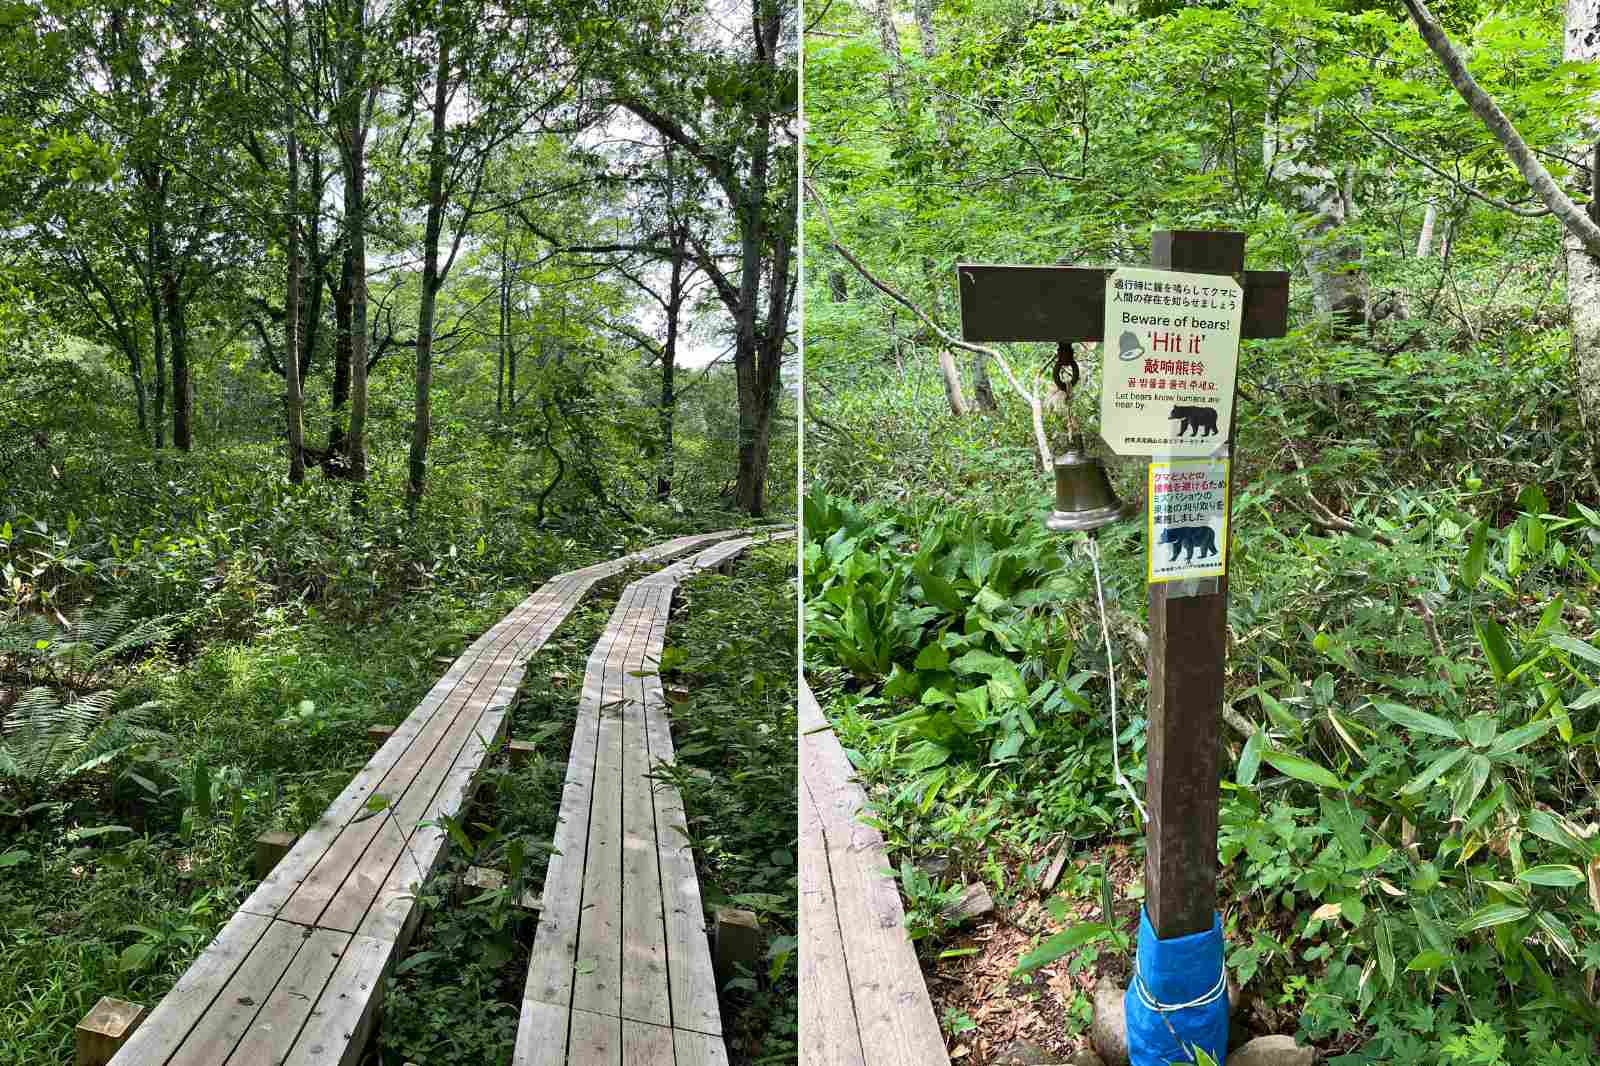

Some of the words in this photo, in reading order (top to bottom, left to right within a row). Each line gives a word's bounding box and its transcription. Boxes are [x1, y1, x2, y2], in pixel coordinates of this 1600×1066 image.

[1114, 291, 1236, 310] 人間の存在を知らせましょう
[1122, 311, 1169, 327] Beware
[1174, 316, 1188, 327] of
[1191, 318, 1230, 330] bears!
[1144, 358, 1205, 376] 敲响熊铃
[1115, 391, 1128, 400] Let
[1130, 391, 1152, 401] bears
[1154, 392, 1175, 401] know
[1176, 393, 1206, 403] humans
[1115, 401, 1133, 409] near
